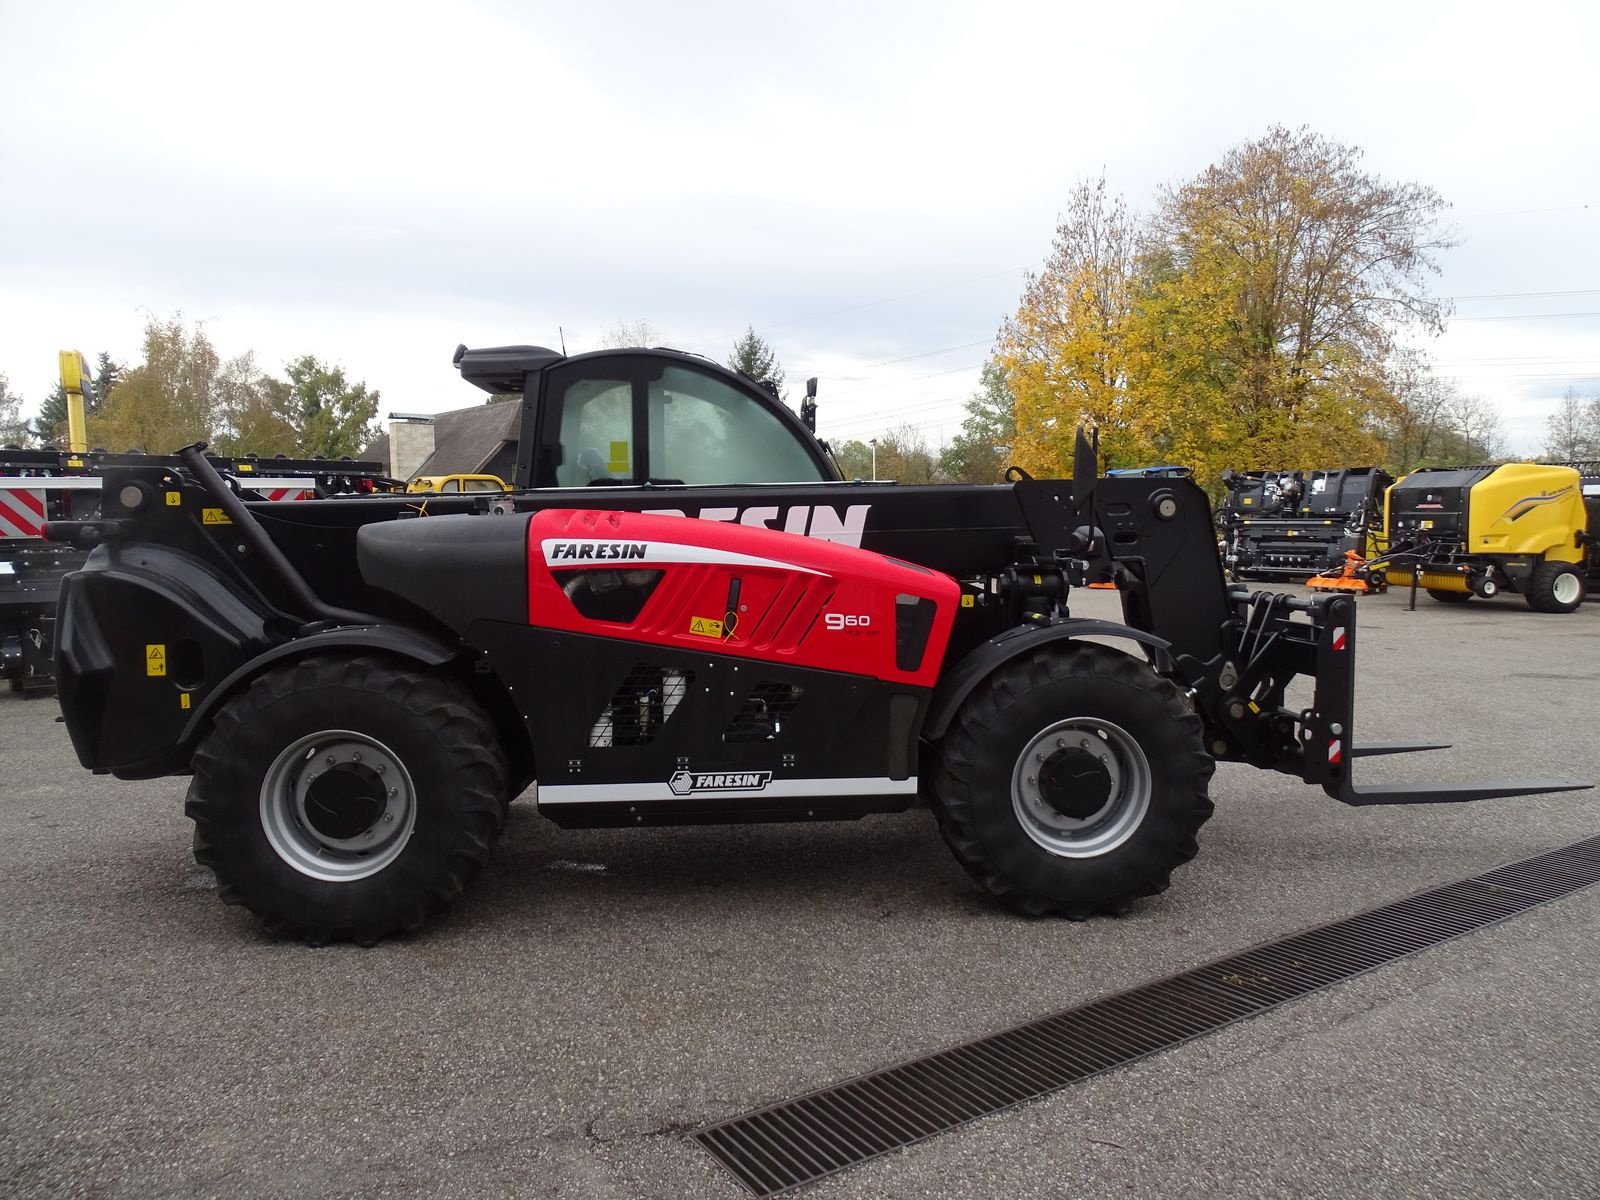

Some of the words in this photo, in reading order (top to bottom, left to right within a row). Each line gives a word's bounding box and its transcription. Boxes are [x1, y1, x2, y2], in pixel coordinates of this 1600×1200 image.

[551, 543, 648, 560] FARESIN
[824, 613, 871, 630] 960
[695, 774, 761, 788] FARESIN
